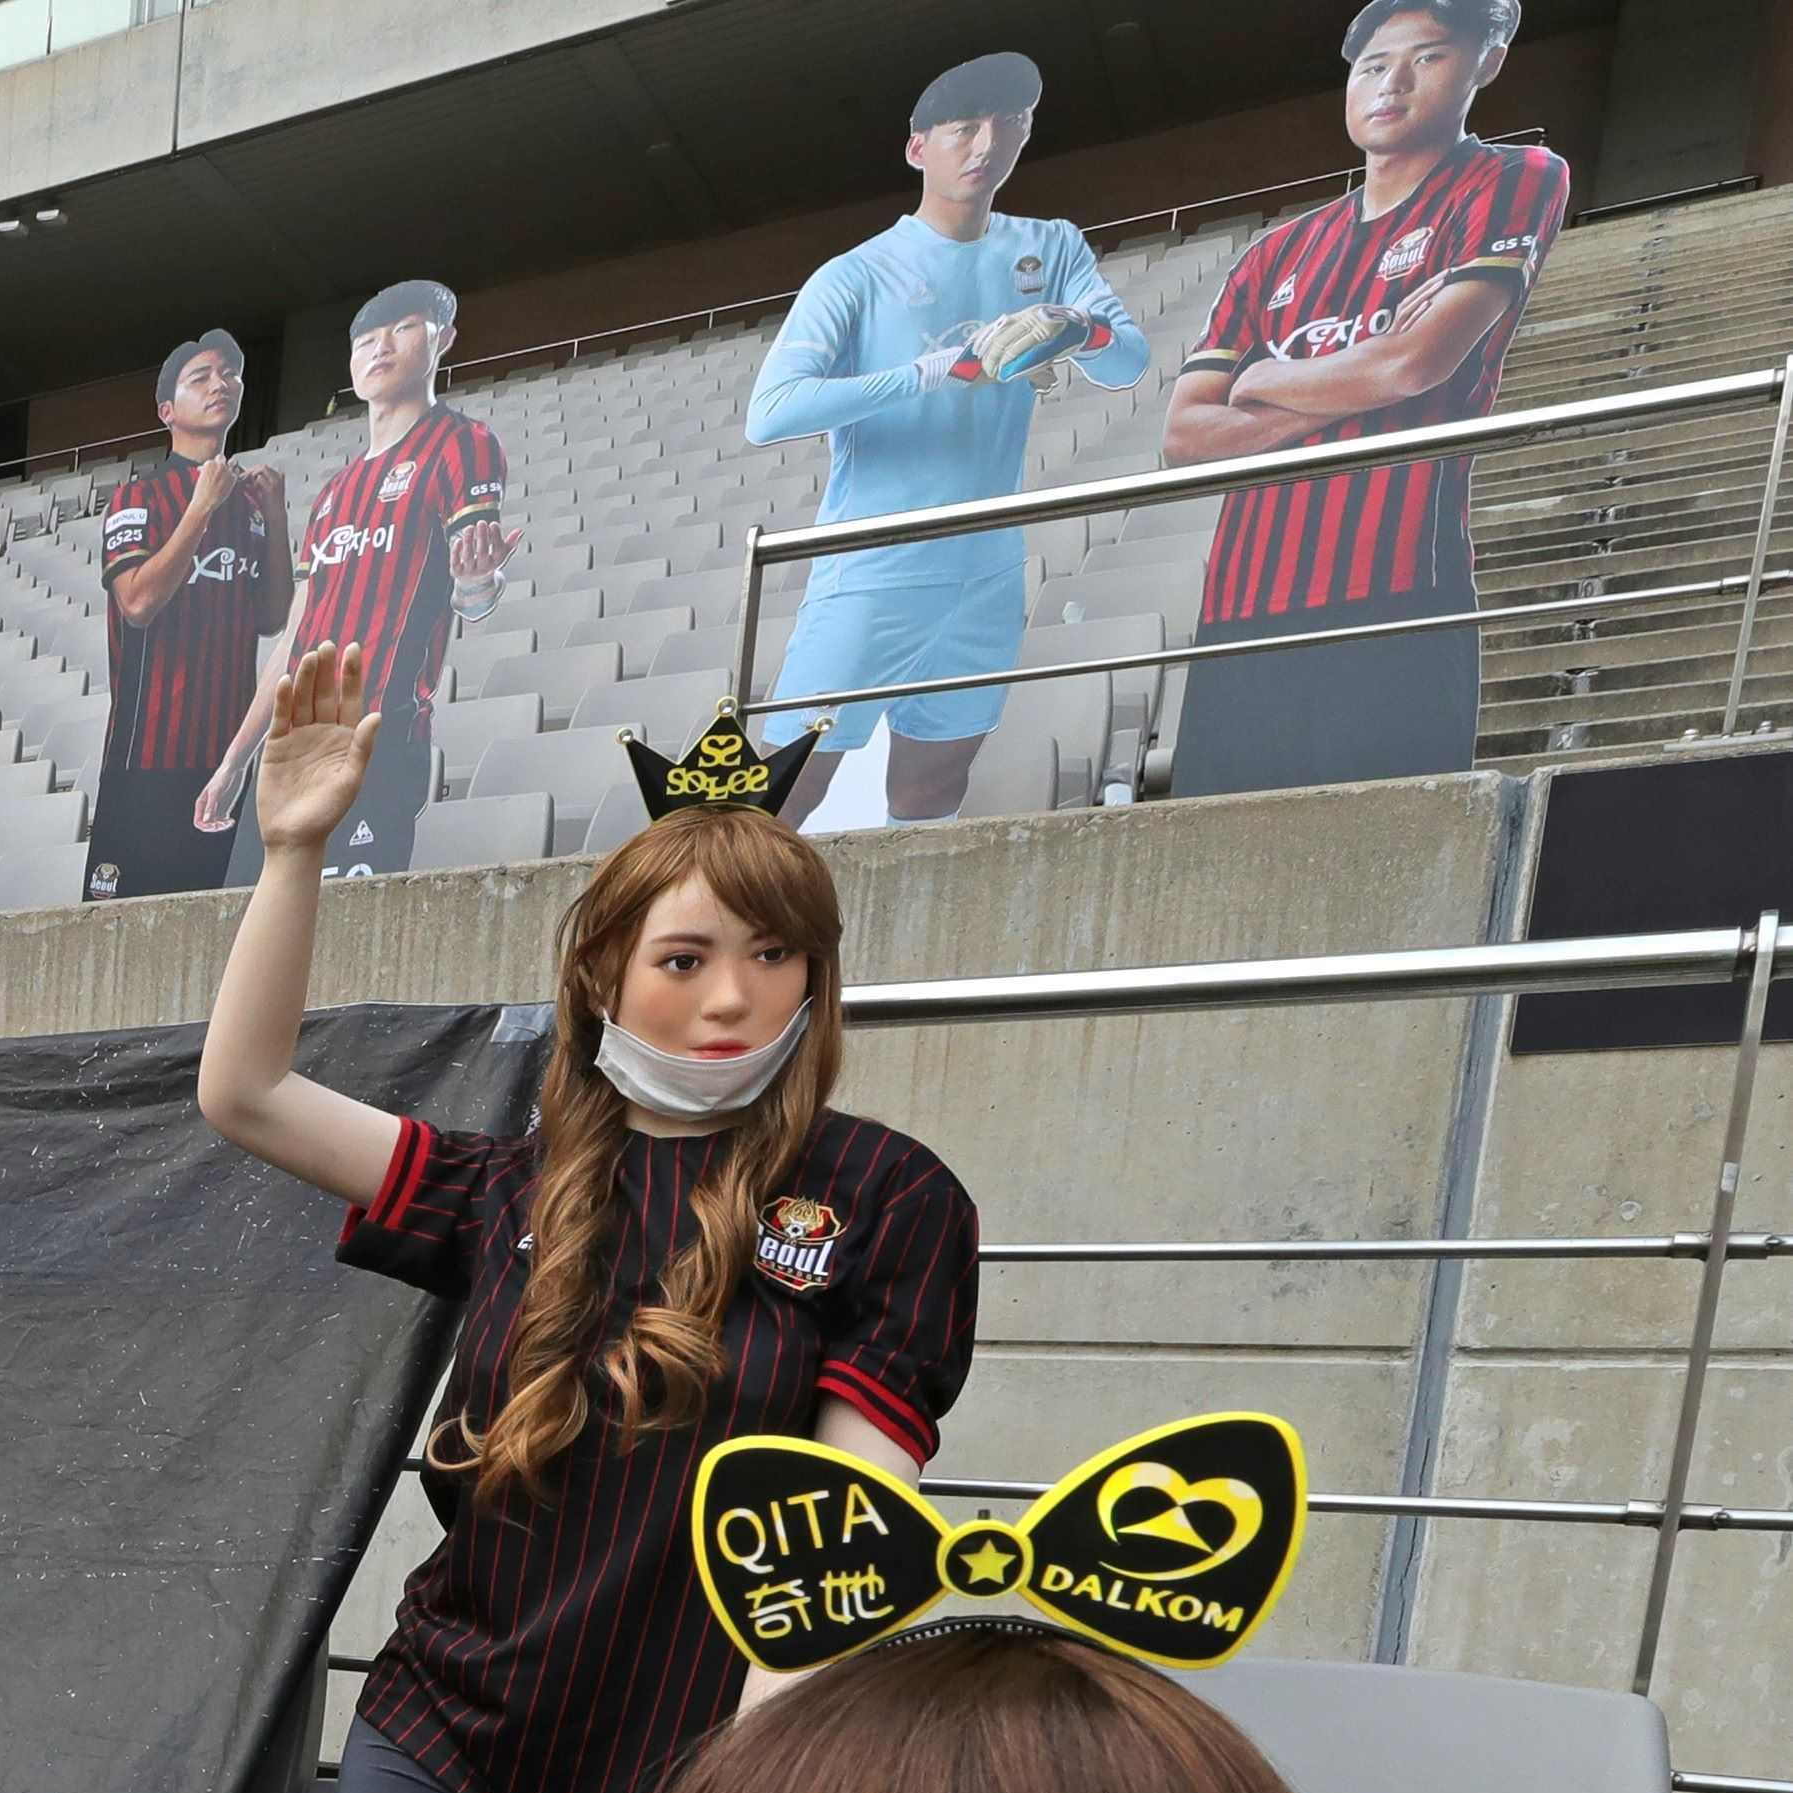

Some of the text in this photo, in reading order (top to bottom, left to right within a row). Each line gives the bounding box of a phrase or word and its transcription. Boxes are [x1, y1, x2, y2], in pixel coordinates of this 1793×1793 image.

[1491, 238, 1517, 252] GS
[106, 529, 143, 550] GS25
[716, 1481, 890, 1573] QITA
[1040, 1562, 1245, 1633] DALKOM
